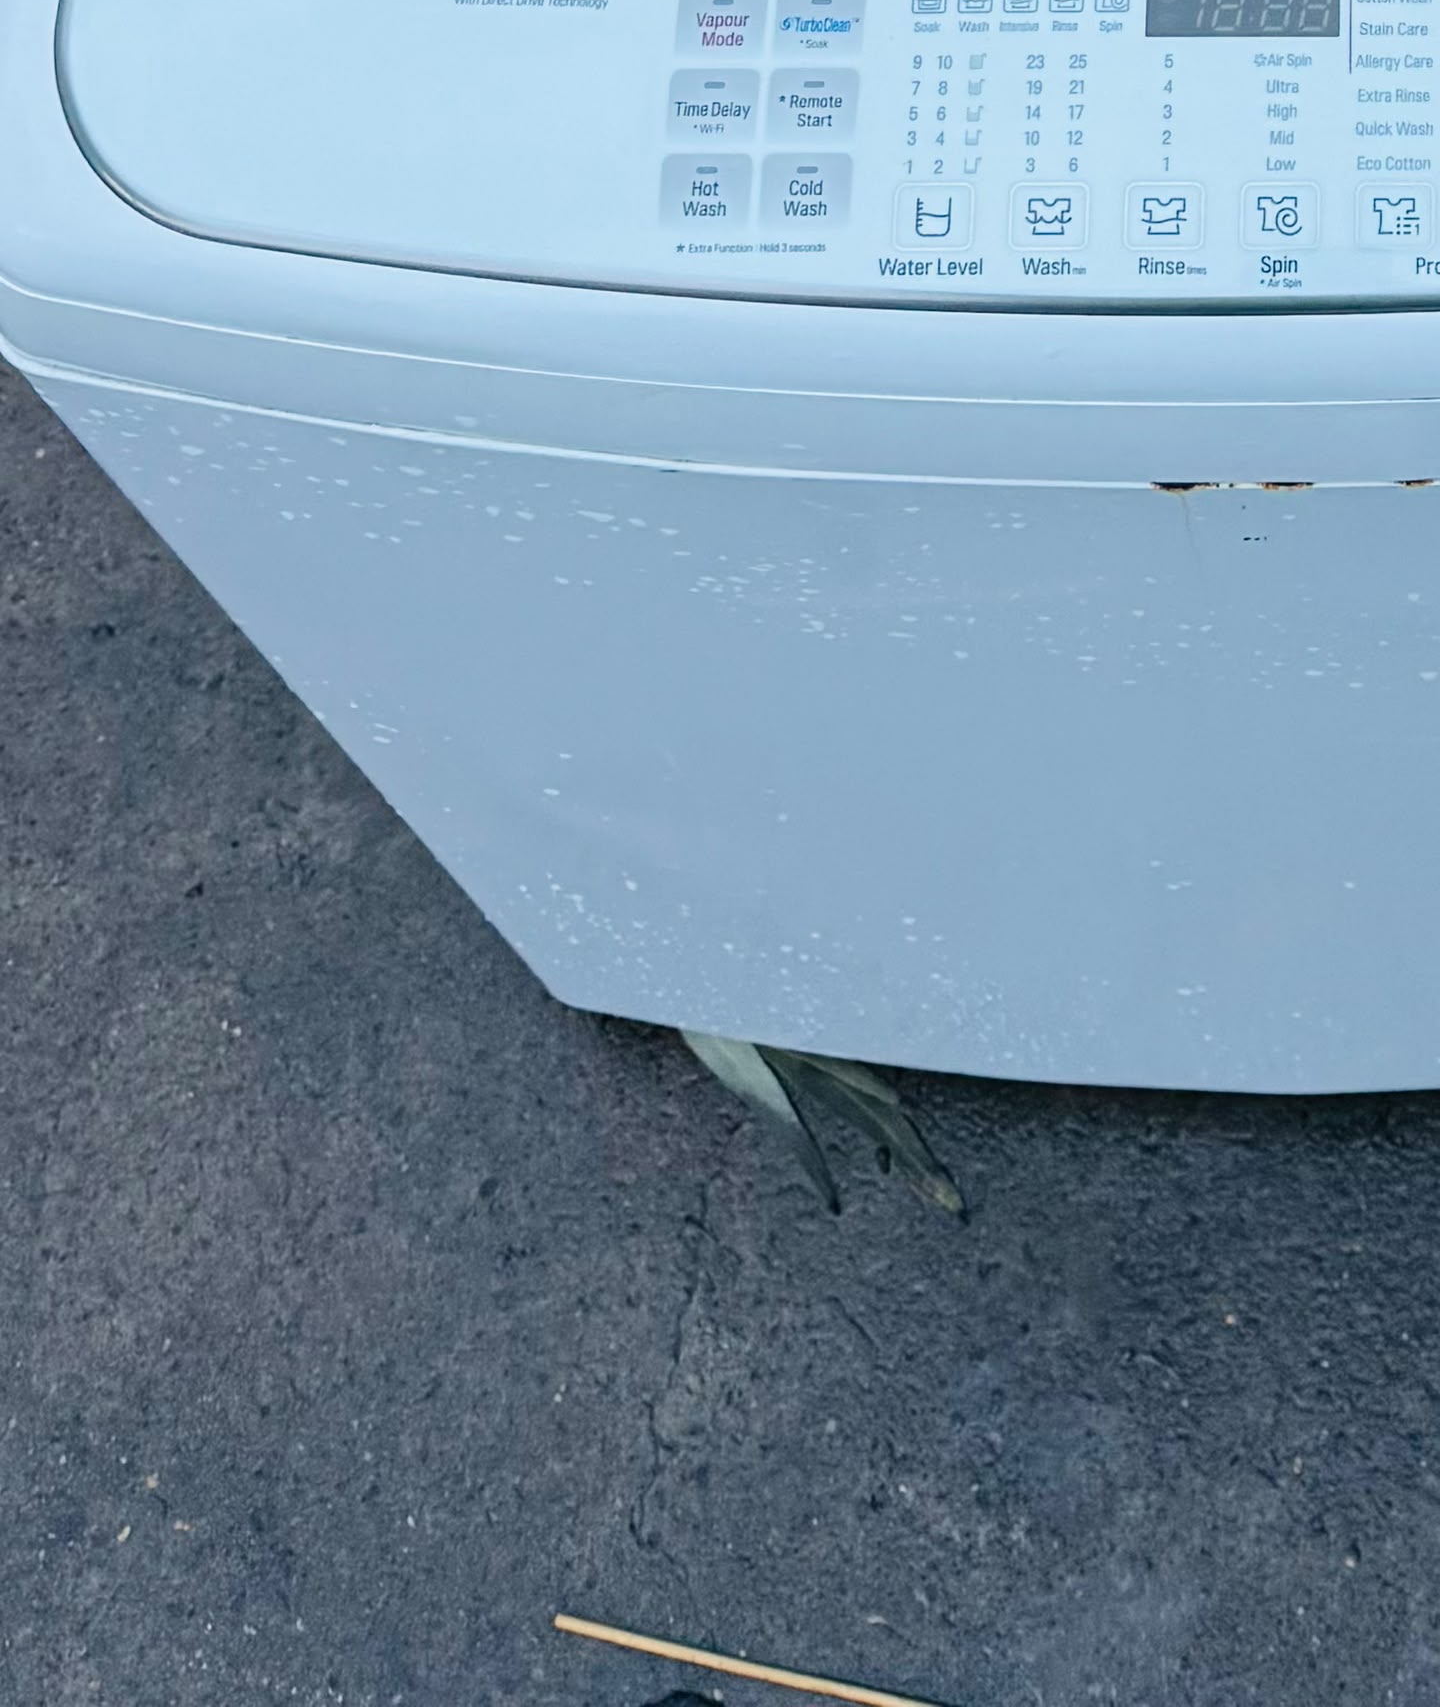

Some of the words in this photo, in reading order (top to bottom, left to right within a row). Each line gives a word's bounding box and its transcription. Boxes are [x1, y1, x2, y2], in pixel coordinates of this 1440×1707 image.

[696, 12, 750, 30] Vapour
[913, 20, 941, 33] Soak
[958, 20, 989, 33] Wash
[1052, 20, 1079, 33] Rinse
[1099, 20, 1124, 34] Spin
[1359, 22, 1394, 36] Stain
[1397, 22, 1429, 36] Care
[701, 31, 744, 47] Mode
[912, 54, 923, 70] 9
[937, 54, 953, 70] 10
[1026, 54, 1045, 70] 23
[1068, 54, 1088, 69] 25
[1164, 54, 1175, 69] 5
[1267, 53, 1285, 68] Air
[1286, 53, 1312, 69] Spin
[1355, 54, 1401, 72] Allergy
[1404, 55, 1434, 69] Care
[911, 81, 921, 96] 7
[938, 81, 948, 96] 8
[1026, 80, 1043, 95] 19
[1068, 80, 1085, 95] 21
[1163, 80, 1173, 95] 4
[1265, 79, 1300, 94] Ultra
[789, 94, 842, 109] Remote
[1357, 88, 1392, 103] Extra
[1395, 88, 1431, 103] Rinse
[674, 101, 708, 117] Time
[711, 101, 751, 120] Delay
[908, 106, 919, 122] 5
[937, 106, 947, 122] 6
[1025, 105, 1041, 120] 14
[1068, 105, 1085, 120] 17
[1162, 105, 1173, 120] 3
[1266, 104, 1298, 121] High
[797, 113, 833, 128] Start
[1355, 121, 1392, 137] Quick
[1395, 121, 1434, 136] Wash
[906, 131, 917, 146] 3
[935, 131, 946, 147] 4
[1024, 131, 1040, 146] 10
[1067, 130, 1084, 146] 12
[1161, 130, 1172, 146] 2
[1269, 130, 1295, 146] Mid
[905, 159, 914, 175] 1
[933, 159, 944, 175] 2
[1025, 158, 1036, 173] 3
[1068, 157, 1079, 173] 6
[1163, 157, 1171, 172] 1
[1265, 156, 1297, 172] Low
[1356, 156, 1382, 171] Eco
[1385, 156, 1431, 172] Cotton
[691, 180, 719, 197] Hot
[788, 180, 824, 197] Cold
[682, 201, 727, 218] Wash
[783, 201, 827, 217] Wash
[688, 243, 713, 254] Extra
[714, 243, 754, 253] Function
[759, 242, 780, 253] Hold
[781, 243, 788, 252] 3
[789, 243, 826, 253] seconds
[878, 257, 933, 276] Water
[937, 257, 984, 276] Level
[1022, 256, 1070, 276] Wash
[1138, 256, 1185, 276] Rinse
[1260, 255, 1298, 277] Spin
[1267, 278, 1280, 288] Air
[1282, 278, 1302, 289] Spin
